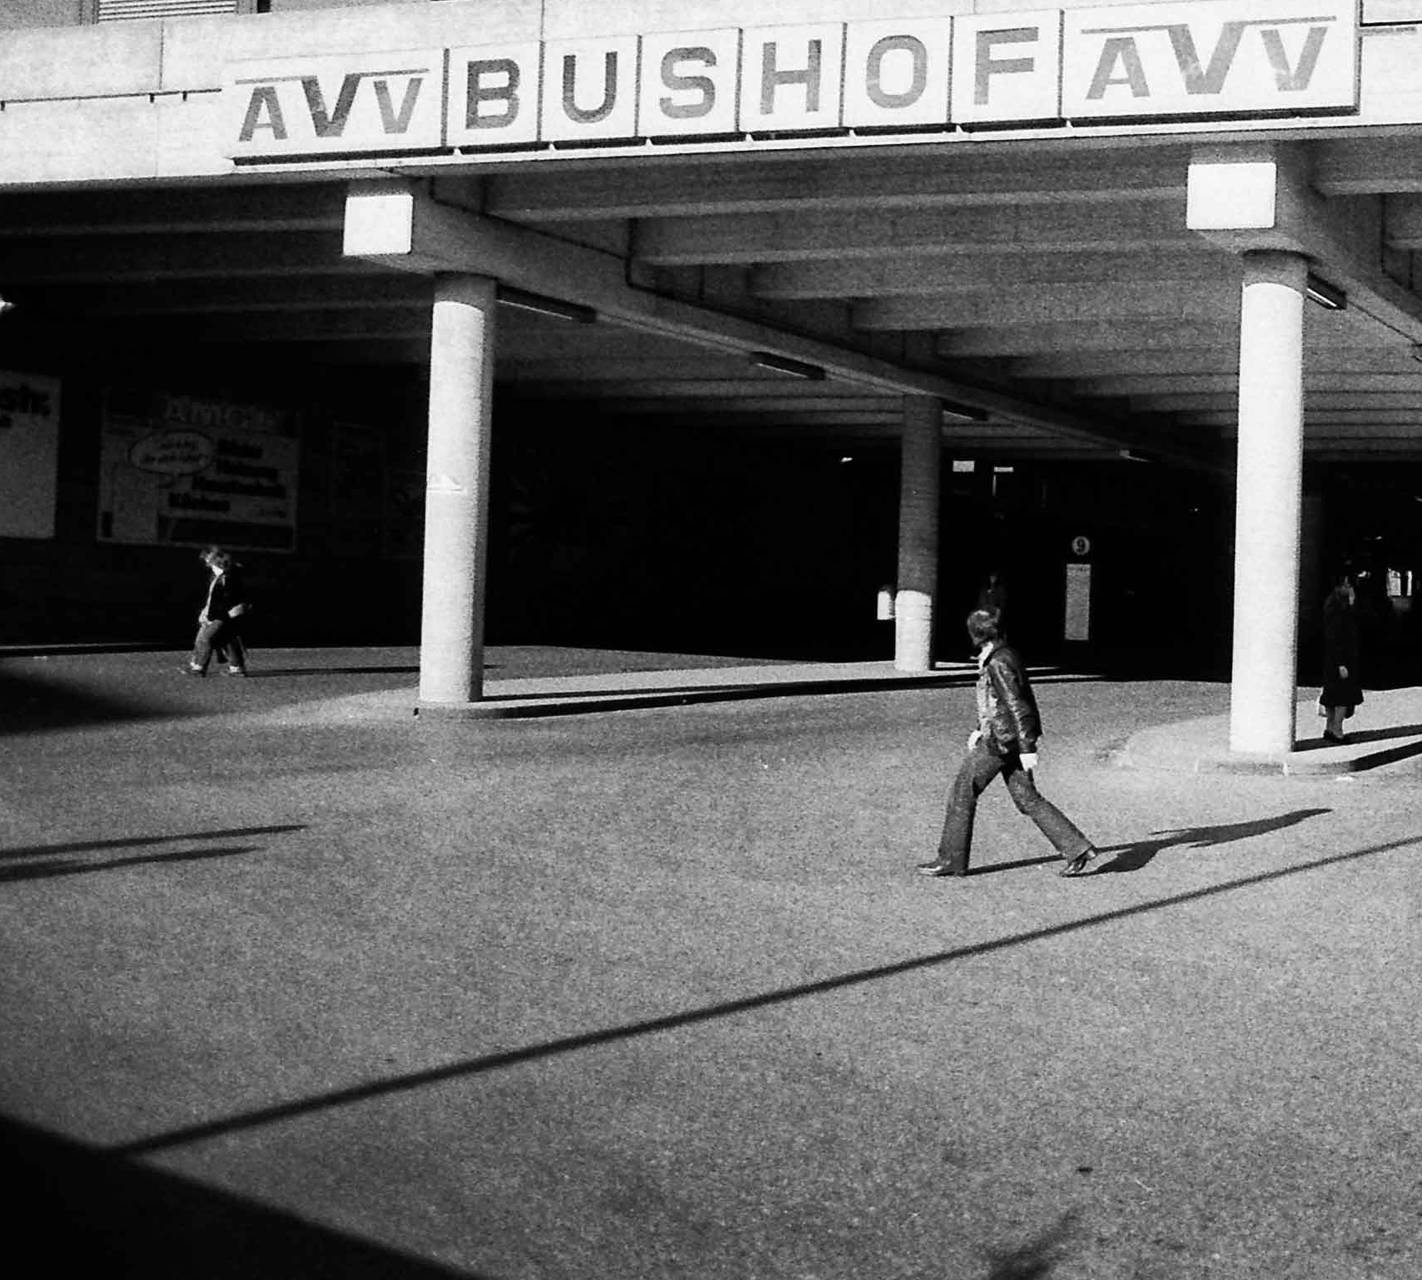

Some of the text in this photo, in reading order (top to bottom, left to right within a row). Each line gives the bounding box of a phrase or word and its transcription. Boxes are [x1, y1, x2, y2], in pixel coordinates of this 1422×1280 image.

[236, 16, 1337, 142] AVV BUSHOF AVV
[1076, 538, 1086, 553] 9
